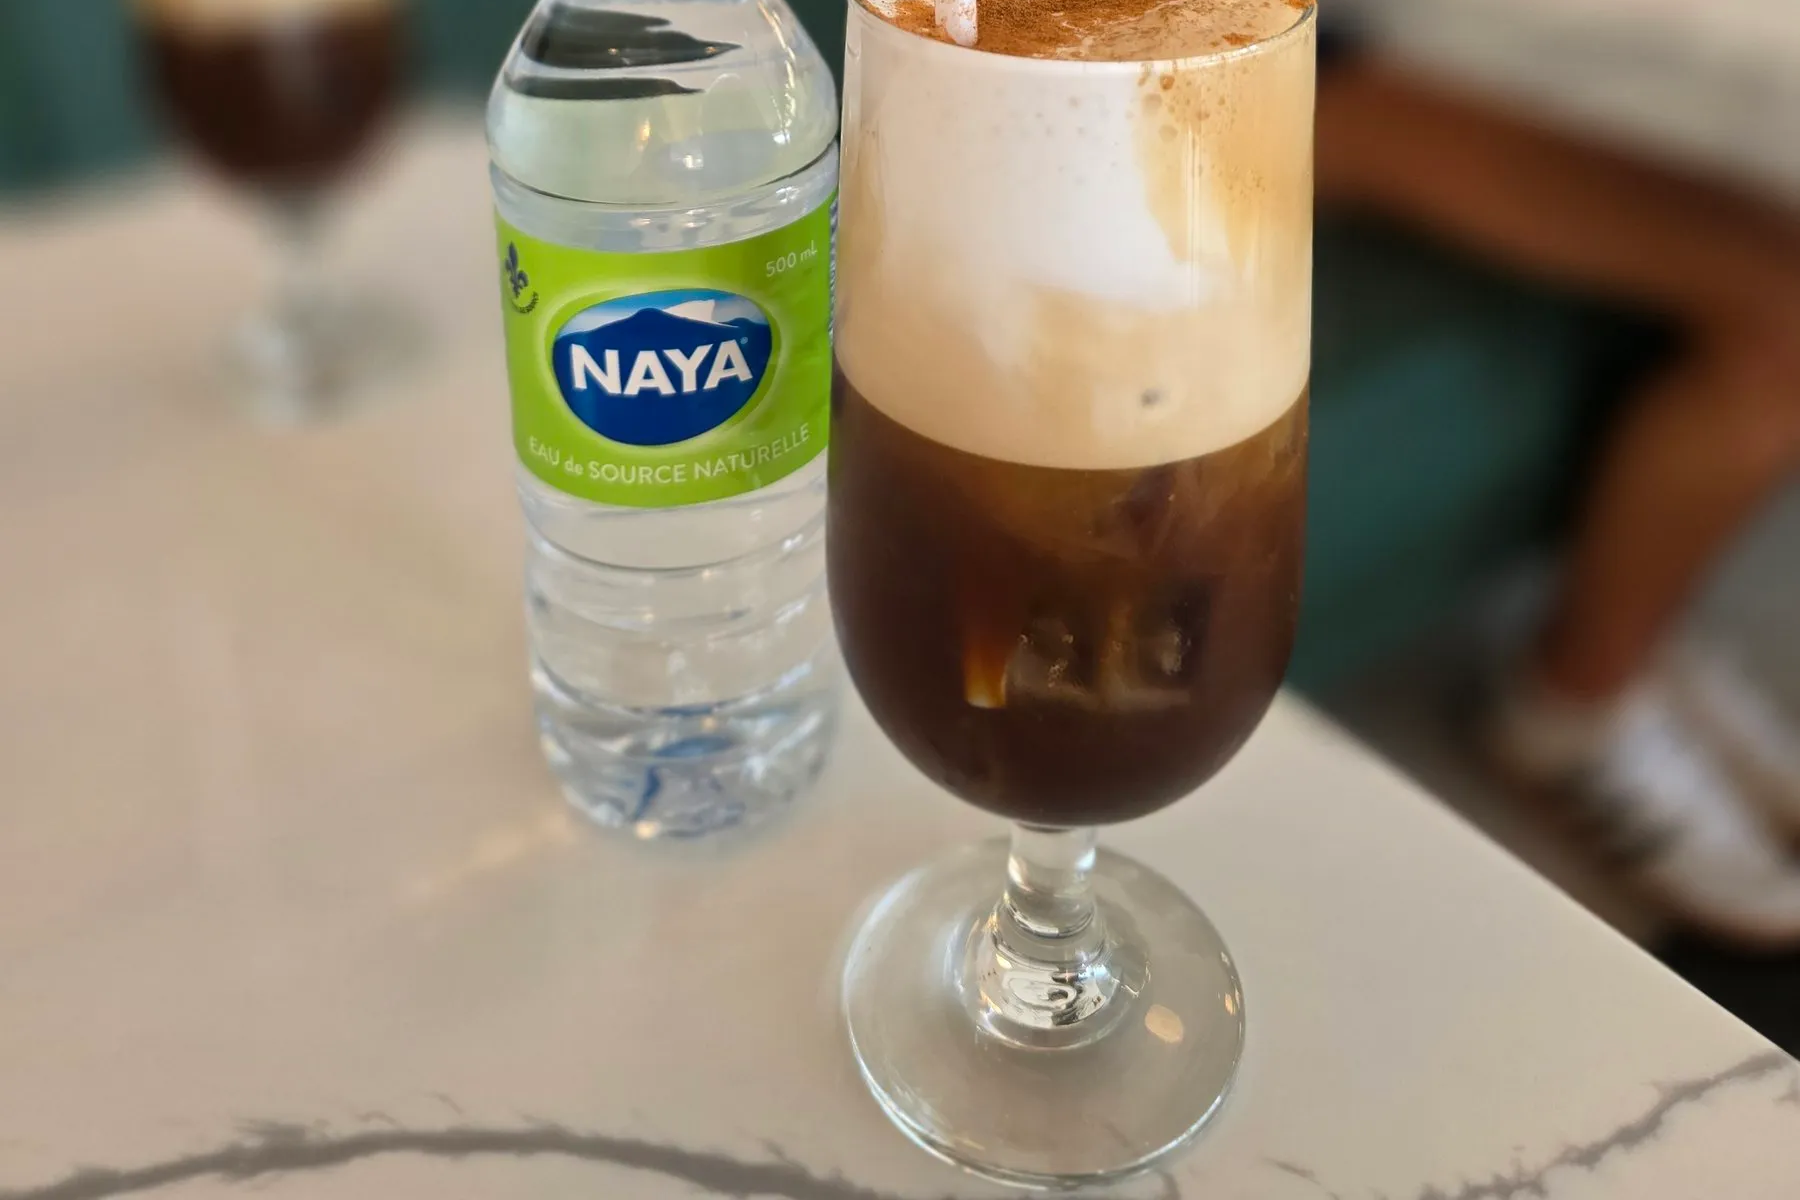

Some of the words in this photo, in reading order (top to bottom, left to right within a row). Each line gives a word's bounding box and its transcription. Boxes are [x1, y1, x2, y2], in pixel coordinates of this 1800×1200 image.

[766, 252, 797, 278] 500
[800, 240, 818, 265] mL
[571, 339, 753, 397] NAYA
[529, 437, 561, 467] EAU
[564, 459, 584, 476] de
[589, 460, 687, 485] SOURCE
[694, 422, 811, 480] NATURELLE
